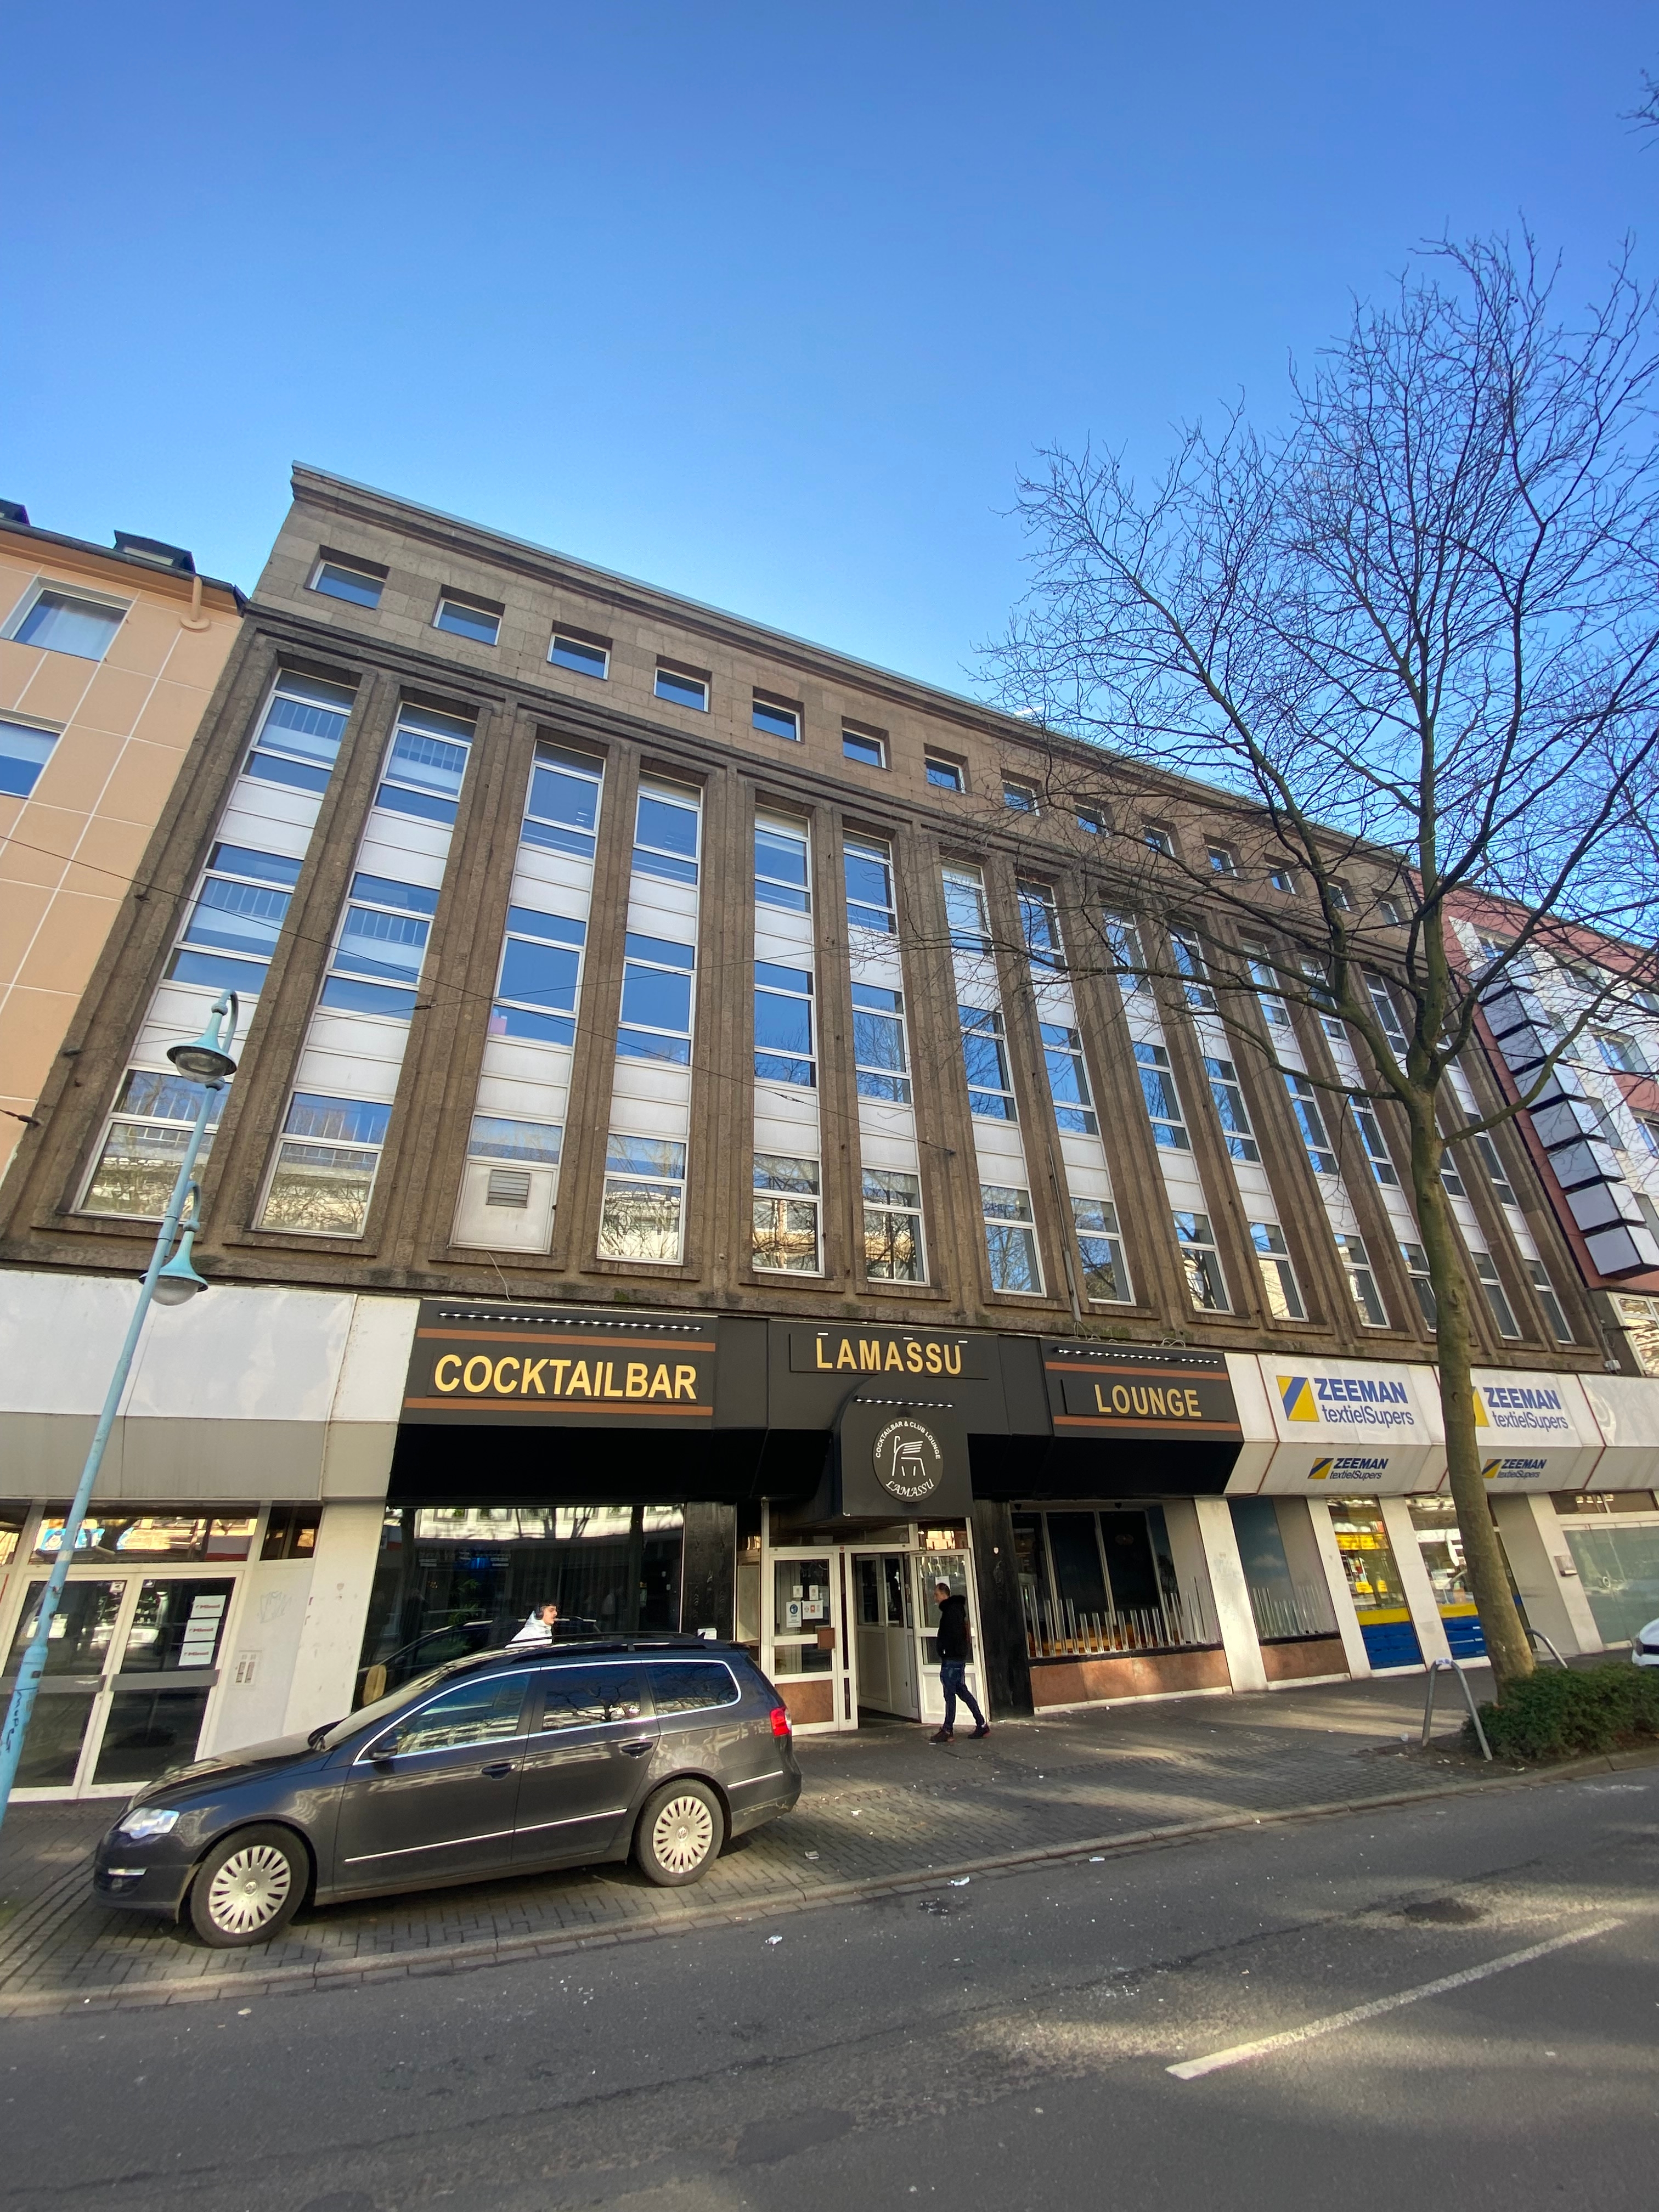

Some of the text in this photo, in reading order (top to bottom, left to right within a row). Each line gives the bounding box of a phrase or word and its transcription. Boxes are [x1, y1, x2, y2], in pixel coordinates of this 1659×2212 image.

[816, 1338, 961, 1375] LAMASSU
[434, 1354, 697, 1400] COCKTAILBAR
[1094, 1384, 1202, 1418] LOUNGE
[1313, 1378, 1409, 1404] ZEEMAN
[1482, 1386, 1562, 1410] ZEEMAN
[1321, 1404, 1414, 1429] textielSupers
[1492, 1411, 1568, 1432] textielSupers
[876, 1421, 903, 1458] COCKTAILBAR
[909, 1421, 926, 1434] CLUB
[924, 1431, 941, 1460] LOUNGE
[1329, 1470, 1383, 1481] textielSupers
[1333, 1458, 1390, 1470] ZEEMAN
[1497, 1470, 1541, 1480] textielSupers
[1500, 1459, 1548, 1469] ZEEMAN
[885, 1478, 934, 1497] LAMASSU
